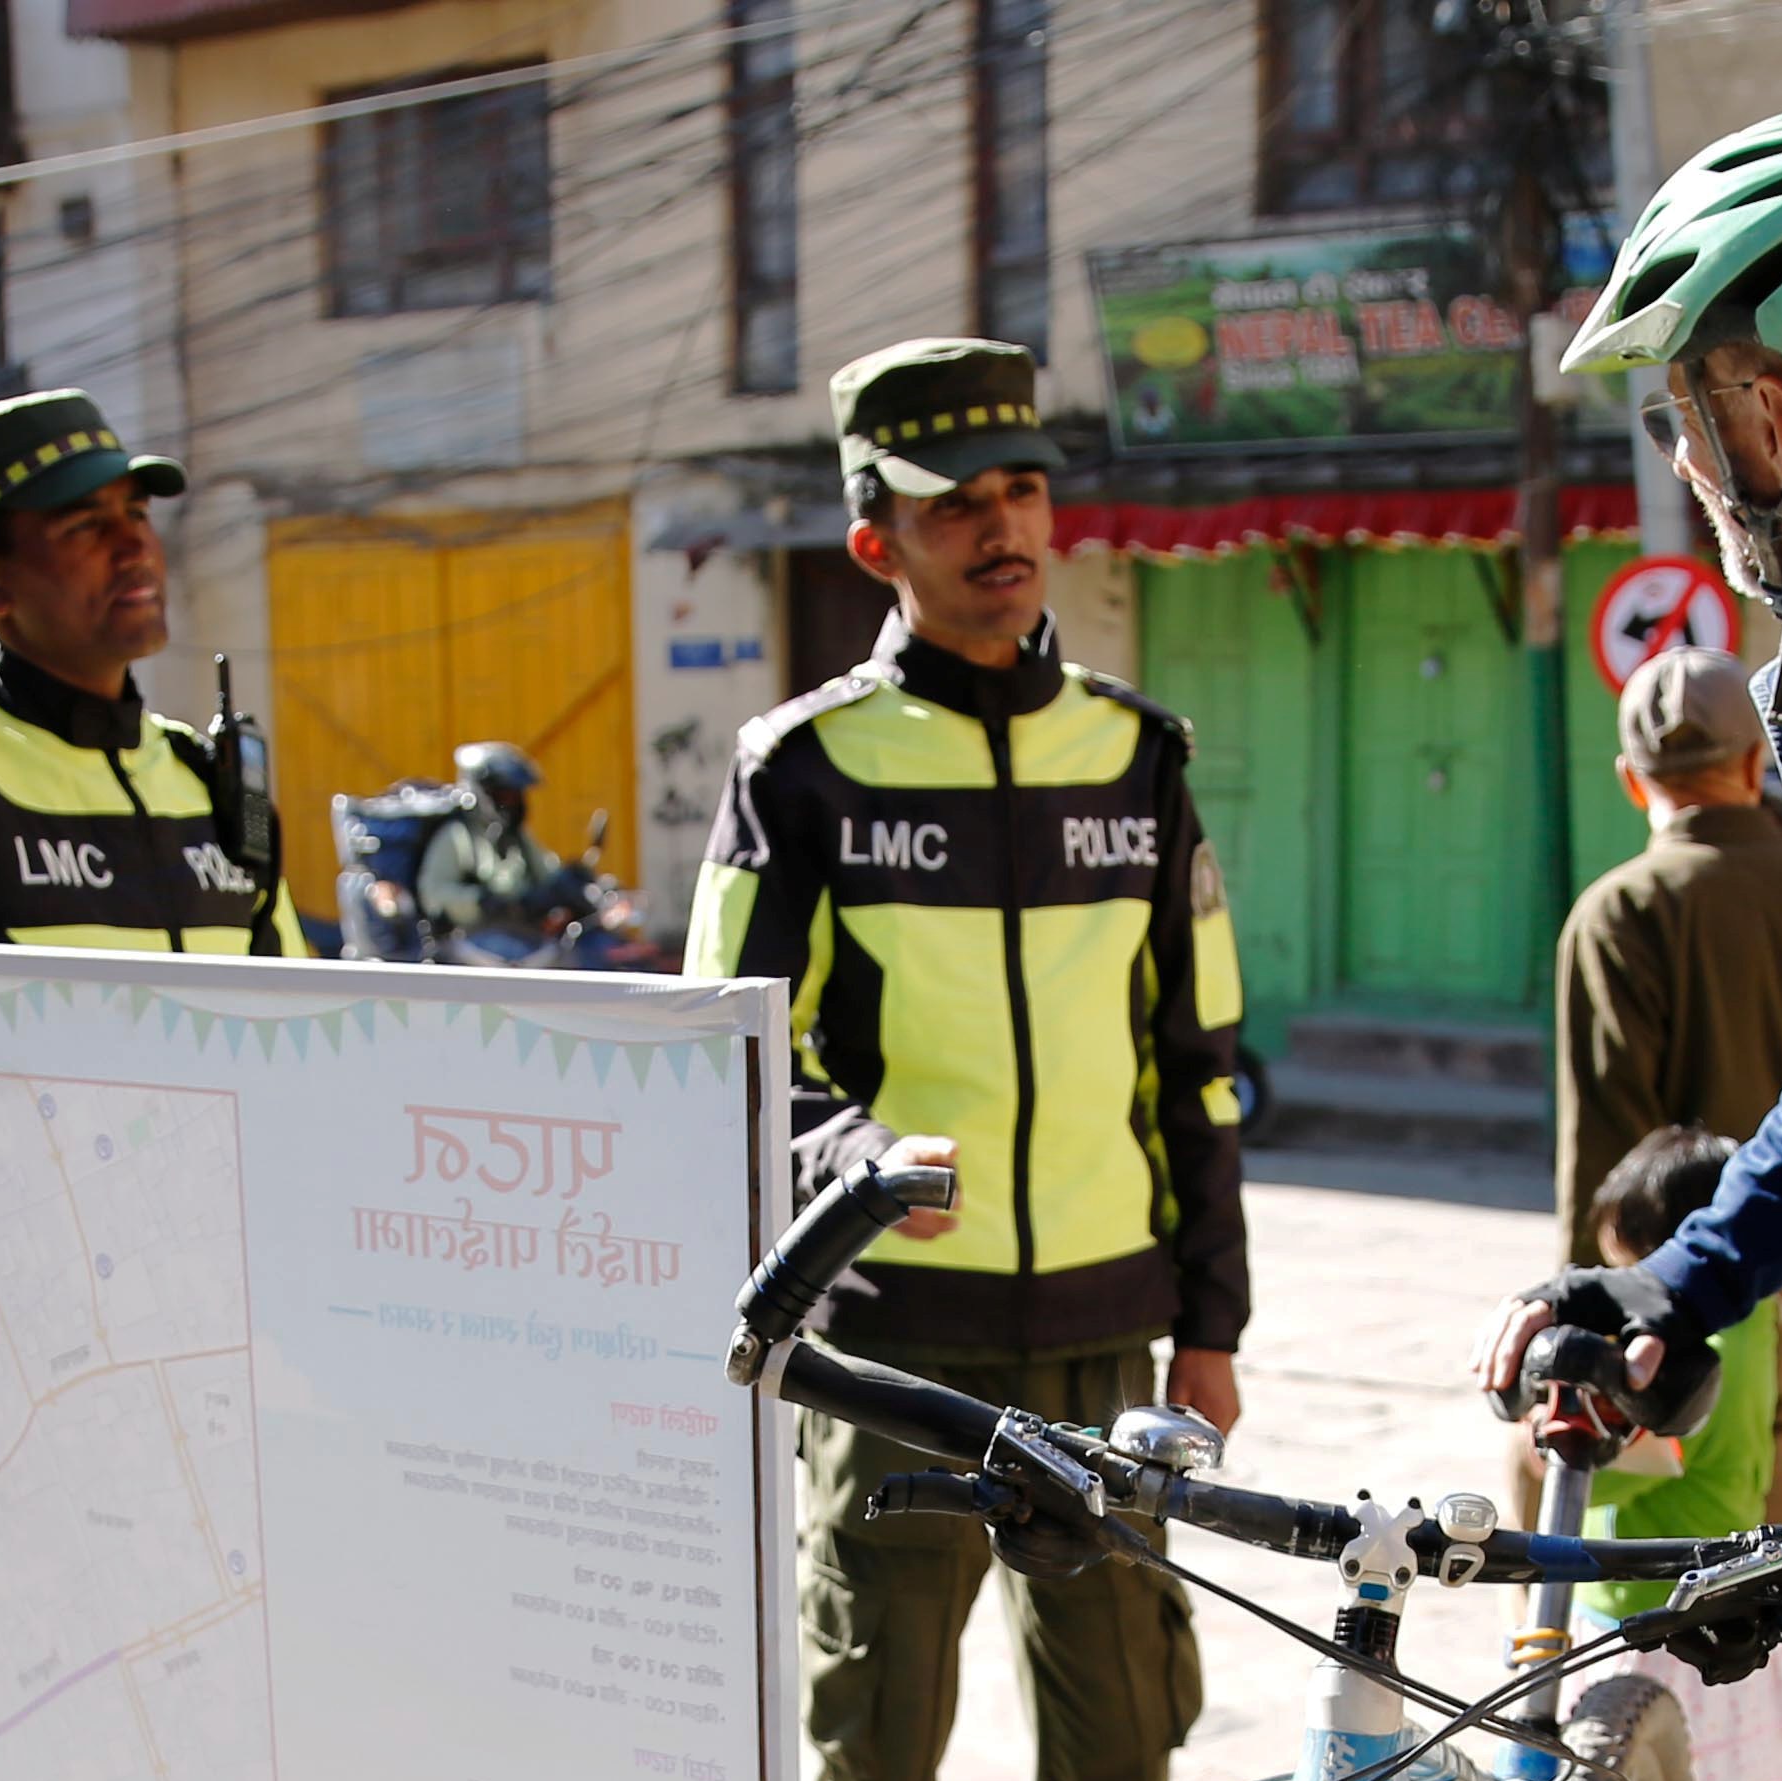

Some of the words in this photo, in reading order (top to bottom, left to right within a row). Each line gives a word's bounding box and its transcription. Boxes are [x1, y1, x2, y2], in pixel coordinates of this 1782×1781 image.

[1215, 307, 1355, 363] NEPAL
[1357, 299, 1447, 353] TEA
[13, 835, 115, 889] LMC
[839, 816, 949, 872] LMC
[1062, 816, 1160, 869] POLICE
